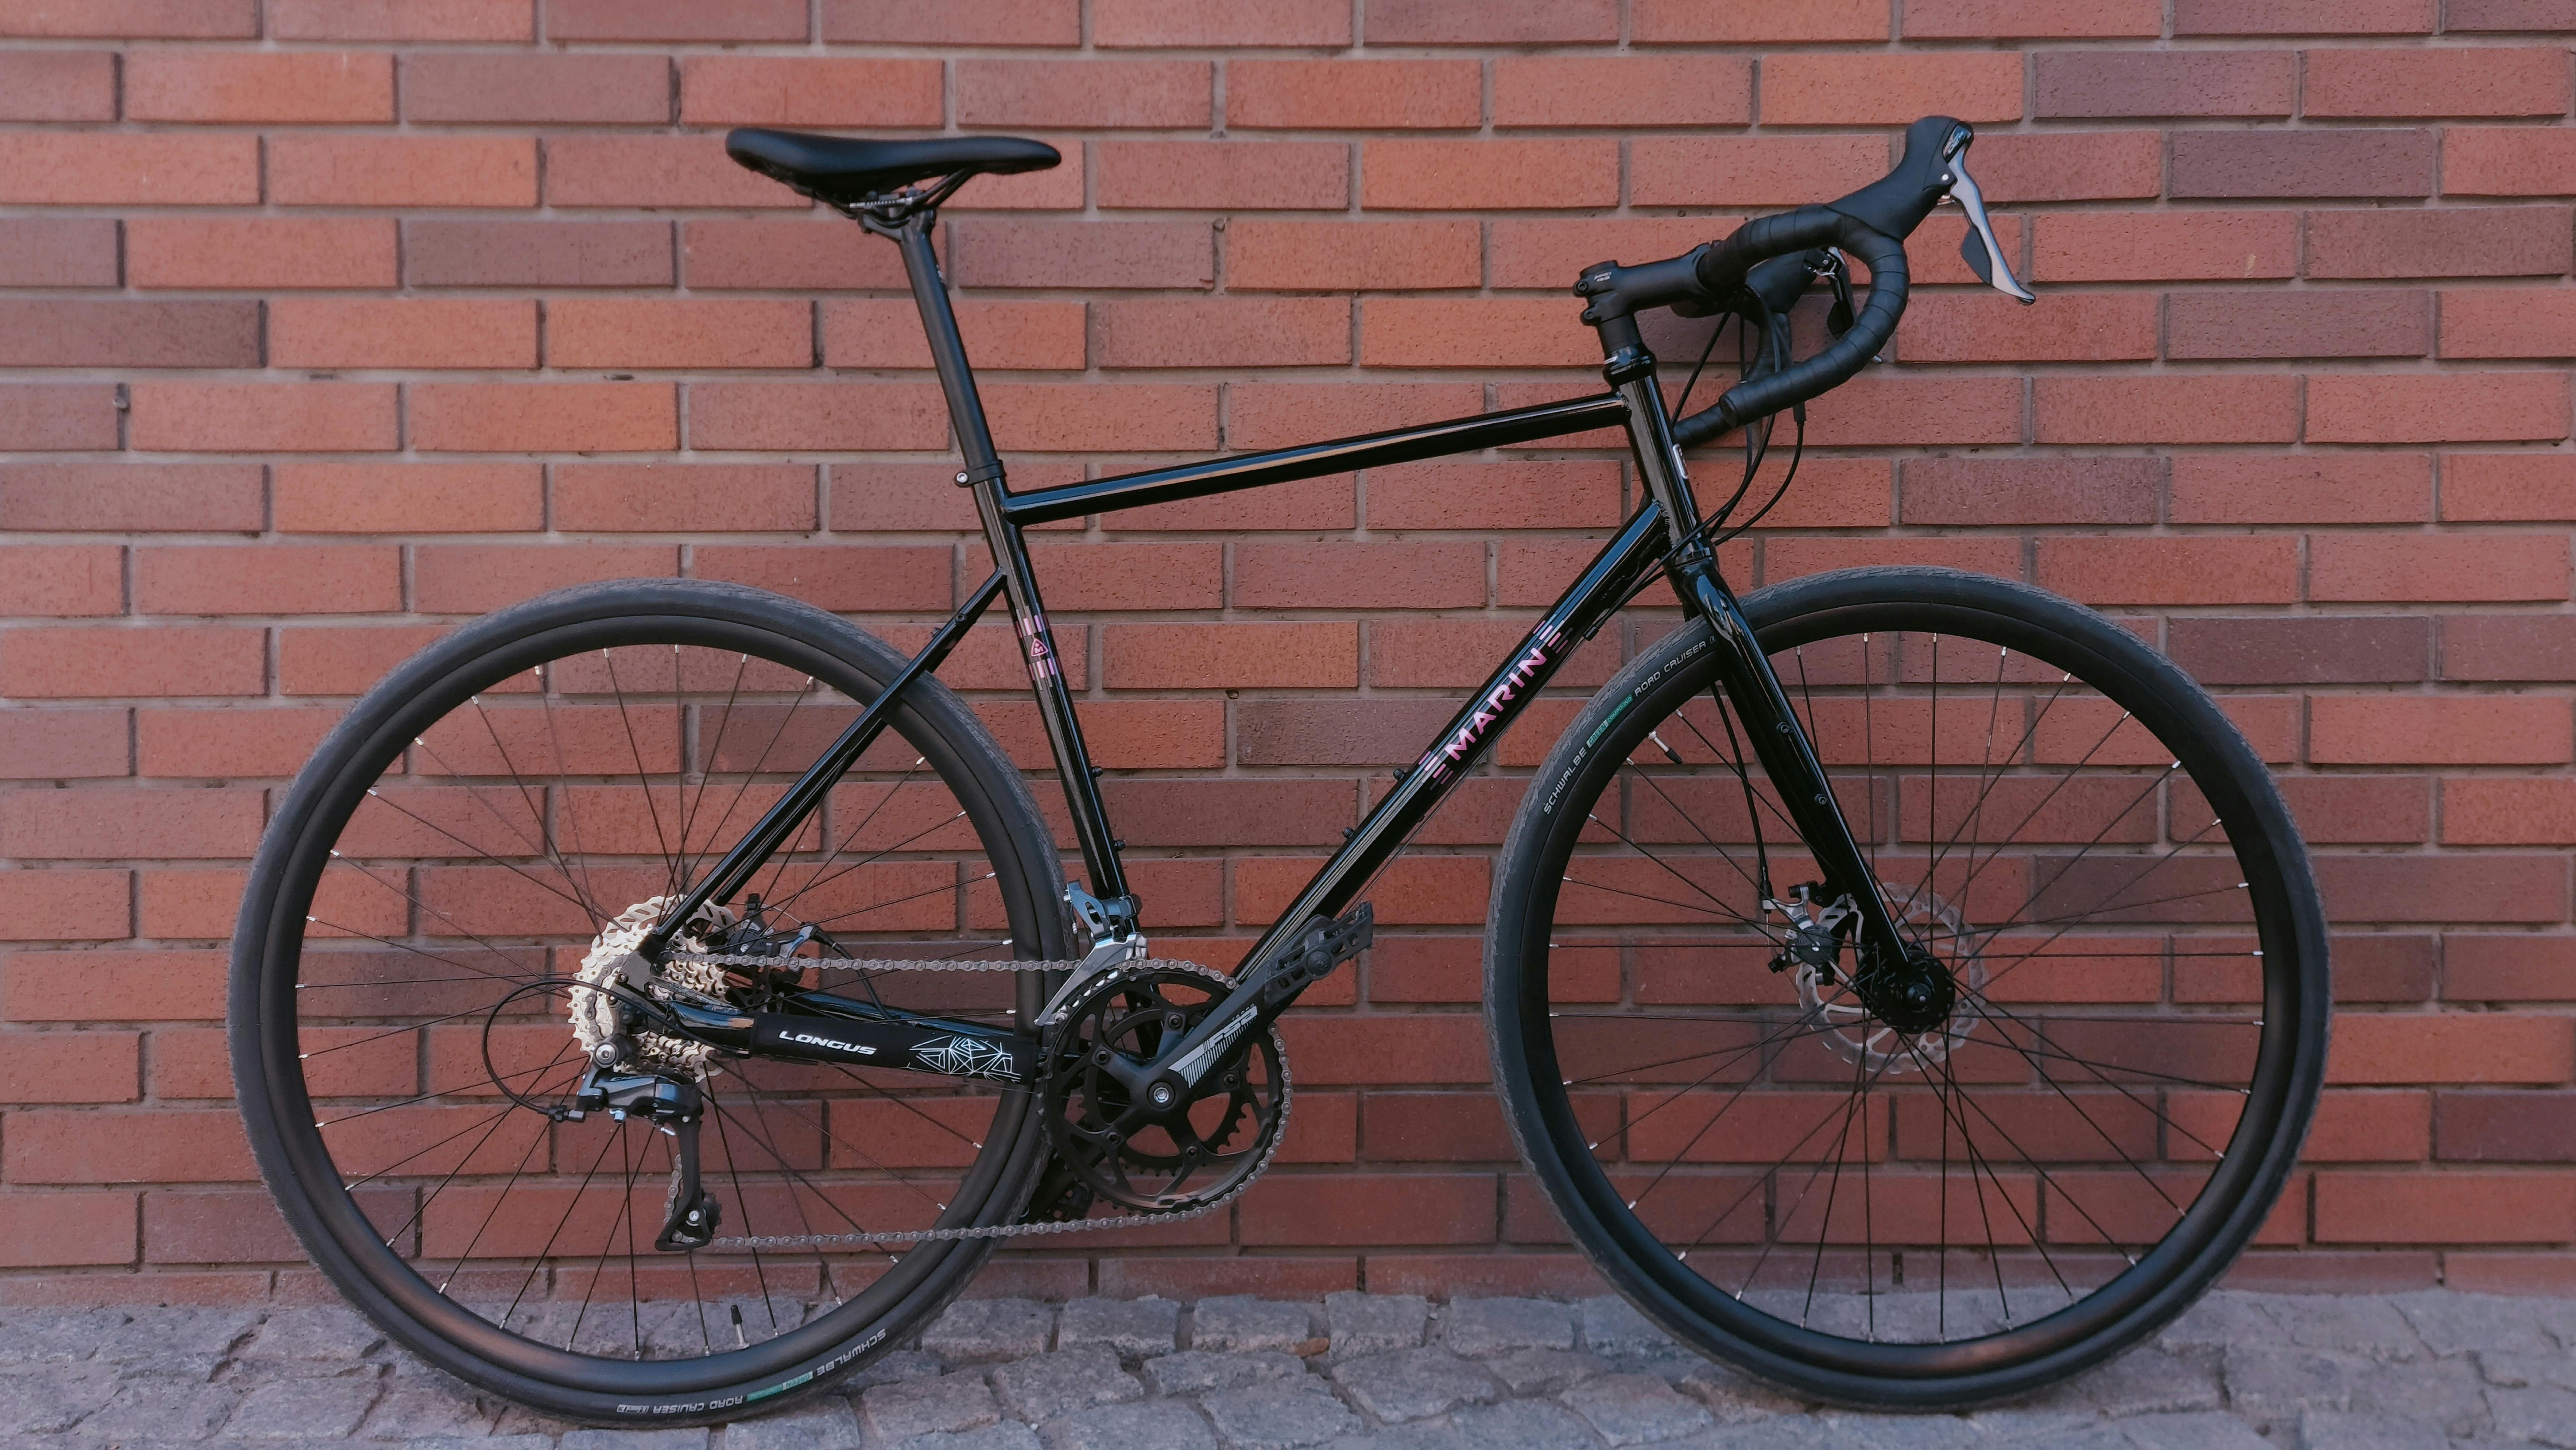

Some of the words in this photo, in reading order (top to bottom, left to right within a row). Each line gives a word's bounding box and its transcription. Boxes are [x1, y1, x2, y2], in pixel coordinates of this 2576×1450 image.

[1444, 648, 1547, 761] MARIN
[1544, 747, 1587, 815] SCHWALBE
[1589, 723, 1606, 745] GREEN
[1607, 697, 1632, 723] COMPOUND
[1634, 671, 1660, 696] ROAD
[1663, 641, 1706, 672] CRUISER
[779, 1031, 877, 1055] LONGUS
[817, 1328, 887, 1376] SCHWALBE
[653, 1403, 704, 1414] CRUISER
[709, 1395, 743, 1410] ROAD
